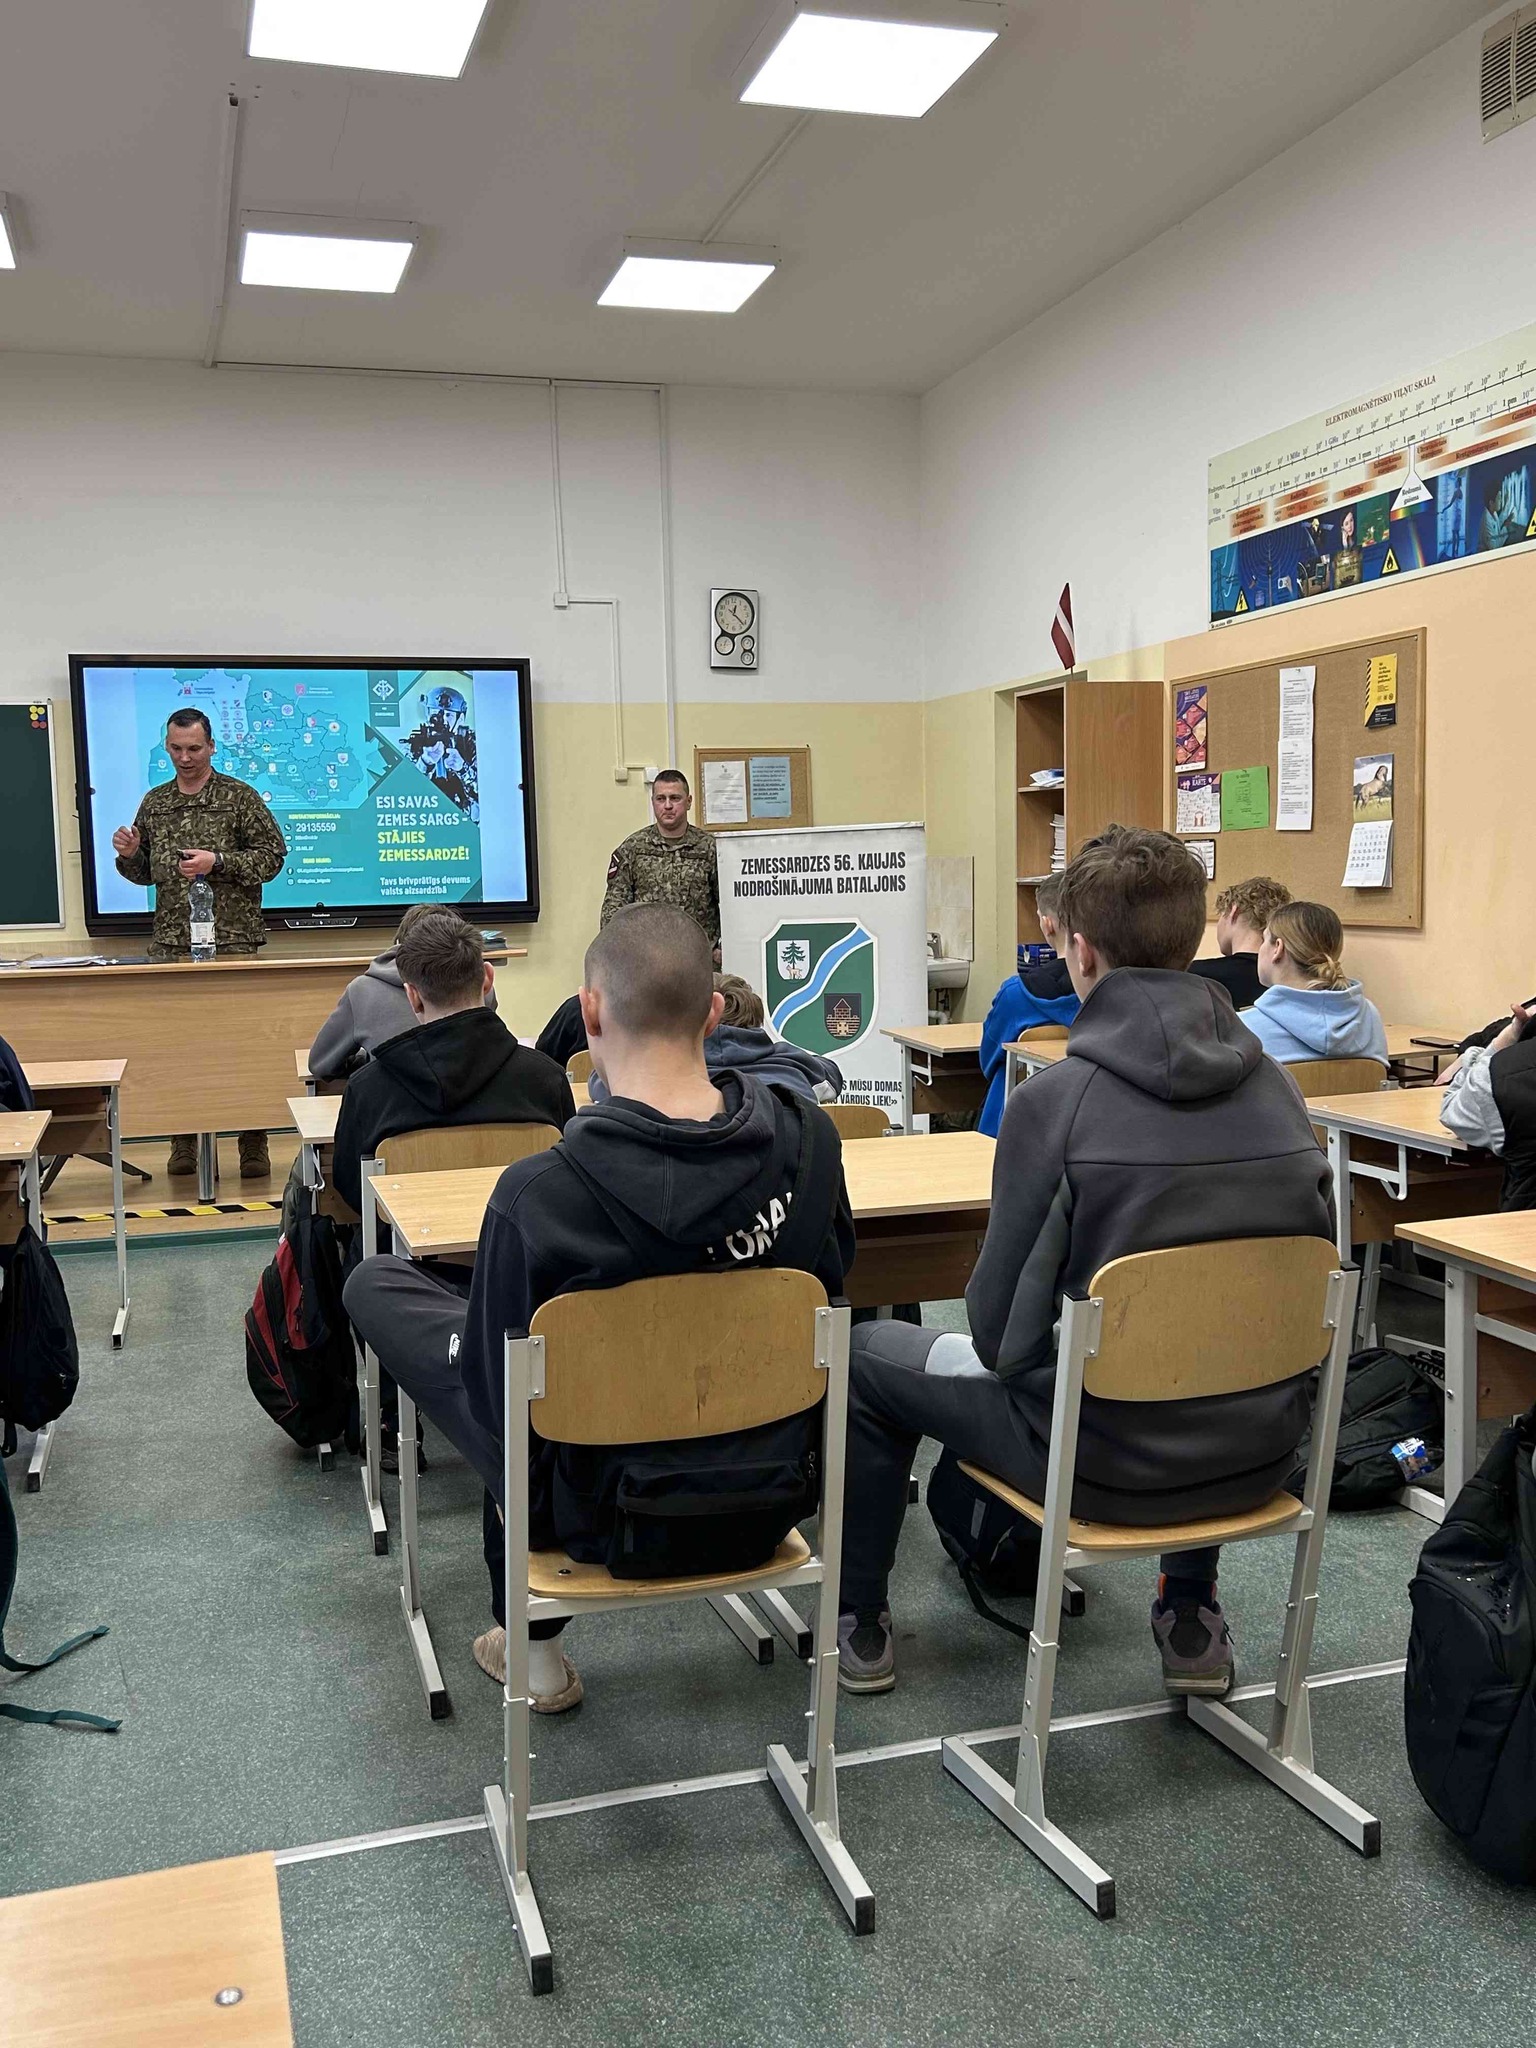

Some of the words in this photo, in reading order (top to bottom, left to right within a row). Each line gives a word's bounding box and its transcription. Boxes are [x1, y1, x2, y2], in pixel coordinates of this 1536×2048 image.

[1325, 392, 1393, 426] ELEKTROMAGNĒTISKO
[1414, 375, 1437, 391] SKALA
[376, 796, 395, 809] ESI
[398, 795, 439, 808] SAVAS
[377, 813, 417, 827] ZEMES
[419, 813, 460, 826] SARGS
[295, 822, 337, 833] 29135559
[377, 829, 426, 844] STĀJIES
[378, 846, 470, 862] ZEMESSARDZĒ!
[741, 855, 831, 876] ZEMESSARDZES
[834, 854, 855, 873] 56.
[858, 851, 906, 871] KAUJAS
[380, 877, 397, 886] Tavs
[398, 876, 441, 887] brīvprātīgs
[441, 875, 471, 885] devums
[734, 875, 834, 898] NODROŠINĀJUMA
[837, 874, 906, 895] BATALJONS
[380, 887, 403, 896] valsts
[404, 886, 447, 896] aizsardzībā
[849, 1079, 872, 1092] MŪSU
[874, 1080, 902, 1093] DOMAS
[840, 1093, 871, 1106] VĀRDUS
